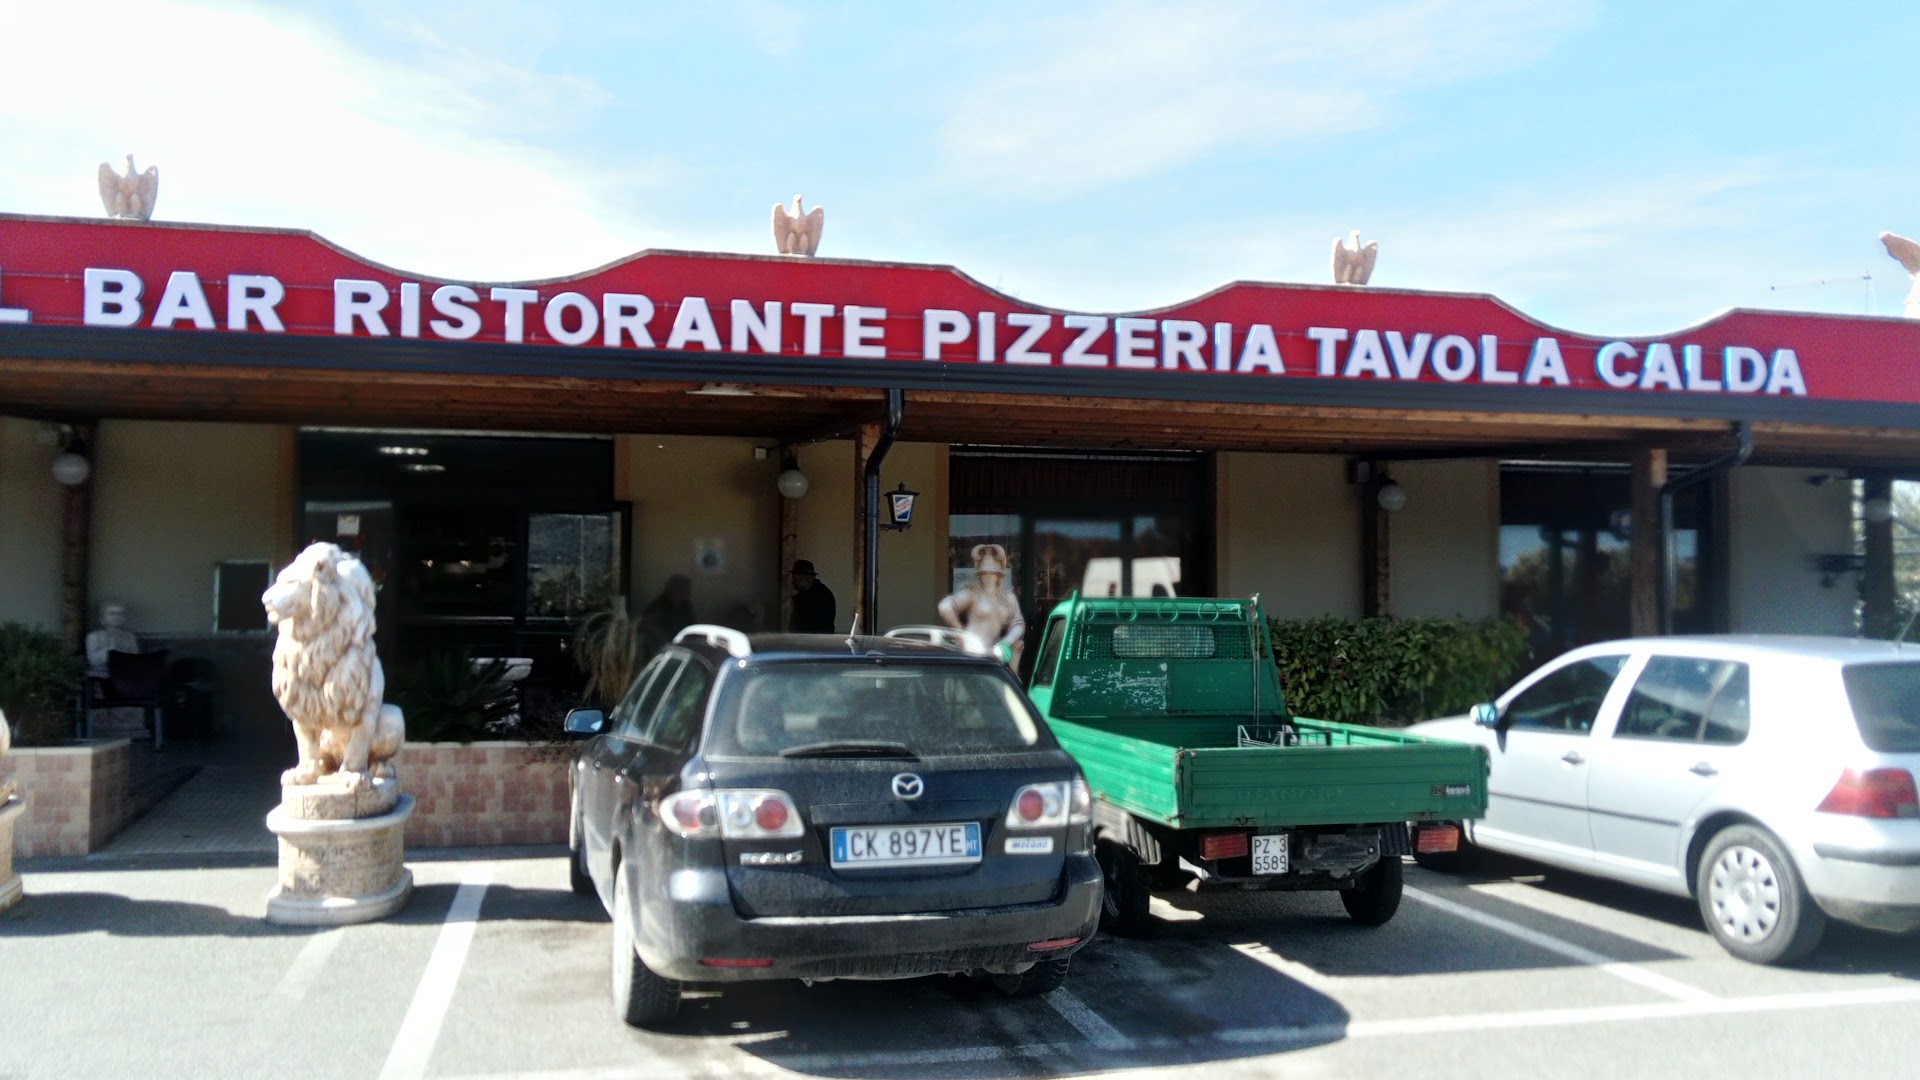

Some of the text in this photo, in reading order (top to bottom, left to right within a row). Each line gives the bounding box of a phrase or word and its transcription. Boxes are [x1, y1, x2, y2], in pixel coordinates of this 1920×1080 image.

[83, 267, 286, 332] BAR
[333, 278, 888, 360] RISTORANTE
[923, 308, 1286, 375] PIZZERIA
[1307, 326, 1571, 387] TAVOLA
[1595, 341, 1808, 396] CALDA
[850, 831, 879, 857] CK
[888, 828, 963, 856] 897YE
[966, 839, 978, 852] MT
[1254, 837, 1287, 854] PZ 3
[1254, 855, 1287, 872] 5589
